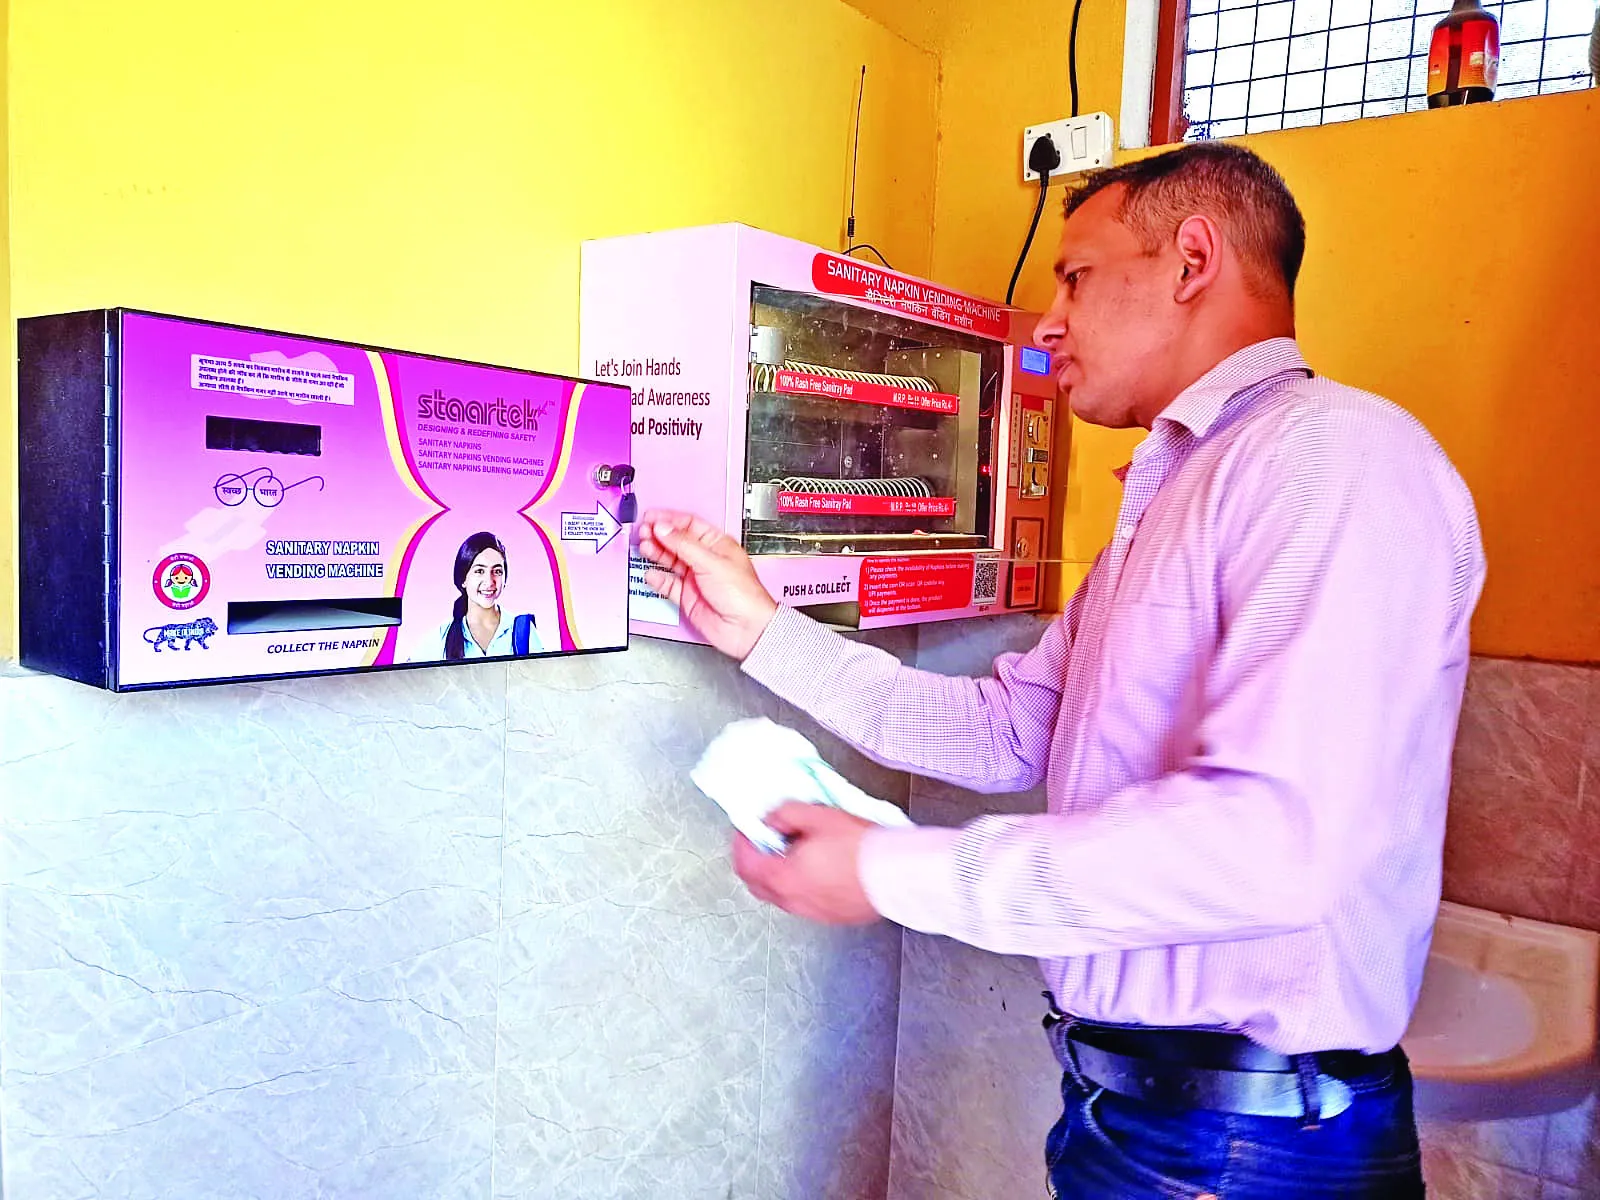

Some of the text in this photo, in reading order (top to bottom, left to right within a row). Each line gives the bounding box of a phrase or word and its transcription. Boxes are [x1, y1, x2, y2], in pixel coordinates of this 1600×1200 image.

[828, 260, 1001, 322] SANITARY NAPKIN VENDING MACHINE
[595, 356, 681, 377] Let's Join Hands
[780, 375, 795, 388] 100%
[795, 376, 809, 390] Rash
[810, 378, 822, 391] Free
[843, 383, 853, 396] Pad
[631, 387, 711, 406] ad Awareness
[417, 388, 539, 431] staartek
[417, 423, 537, 442] DESIGNING & REDEFINING SAFETY
[630, 416, 703, 441] od Positivity
[418, 438, 482, 450] SANITARY NAPKINS
[418, 449, 545, 466] SANITARY NAPKINS VENDING MACHINES
[418, 460, 545, 477] SANITARY NAPKINS BURNING MACHINES
[221, 487, 278, 497] स्वच्छ भारत
[780, 495, 795, 508] 100%
[795, 496, 809, 508] Rash
[810, 497, 821, 508] Free
[842, 498, 852, 510] Pad
[265, 539, 380, 556] SANITARY NAPKIN
[265, 563, 384, 579] VENDING MACHINE
[783, 581, 851, 598] PUSH & COLLECT
[267, 638, 380, 654] COLLECT THE NAPKIN
